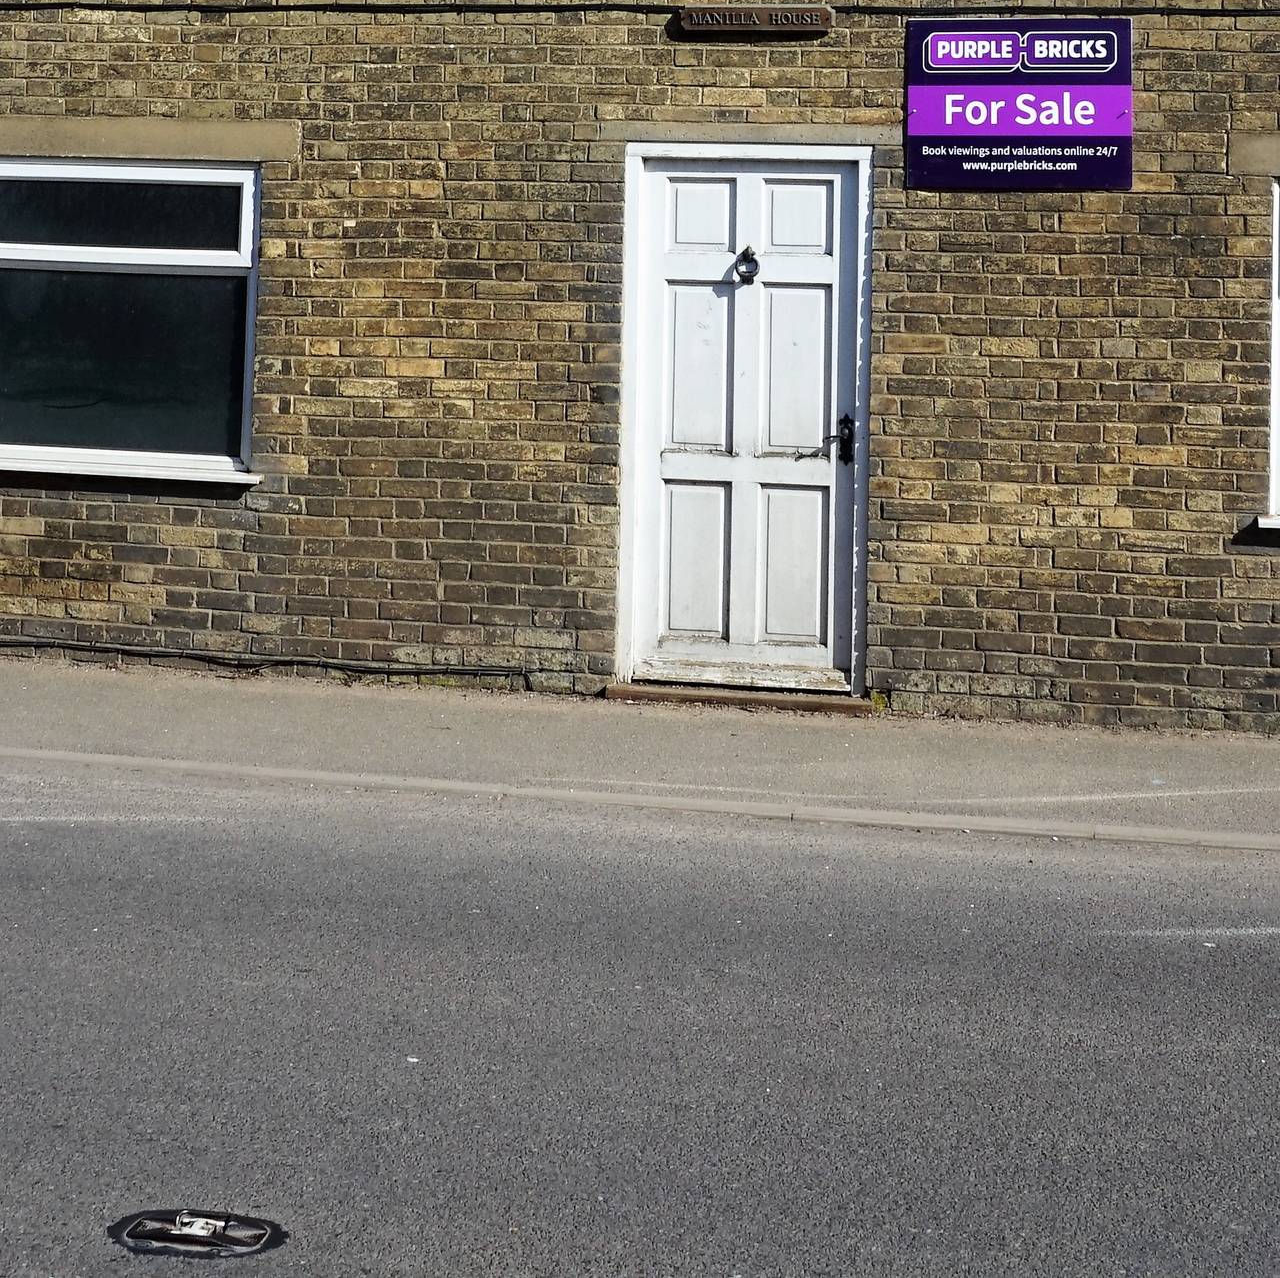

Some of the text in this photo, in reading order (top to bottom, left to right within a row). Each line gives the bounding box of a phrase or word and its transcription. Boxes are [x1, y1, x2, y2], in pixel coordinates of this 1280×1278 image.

[690, 12, 821, 25] MANILLA HOUSE
[937, 39, 1107, 59] PURPLE BRICKS
[945, 91, 1096, 125] For Sale
[922, 145, 1118, 158] Book viewings and valuations online 24/7
[962, 160, 1077, 173] www.purplebricks.com
